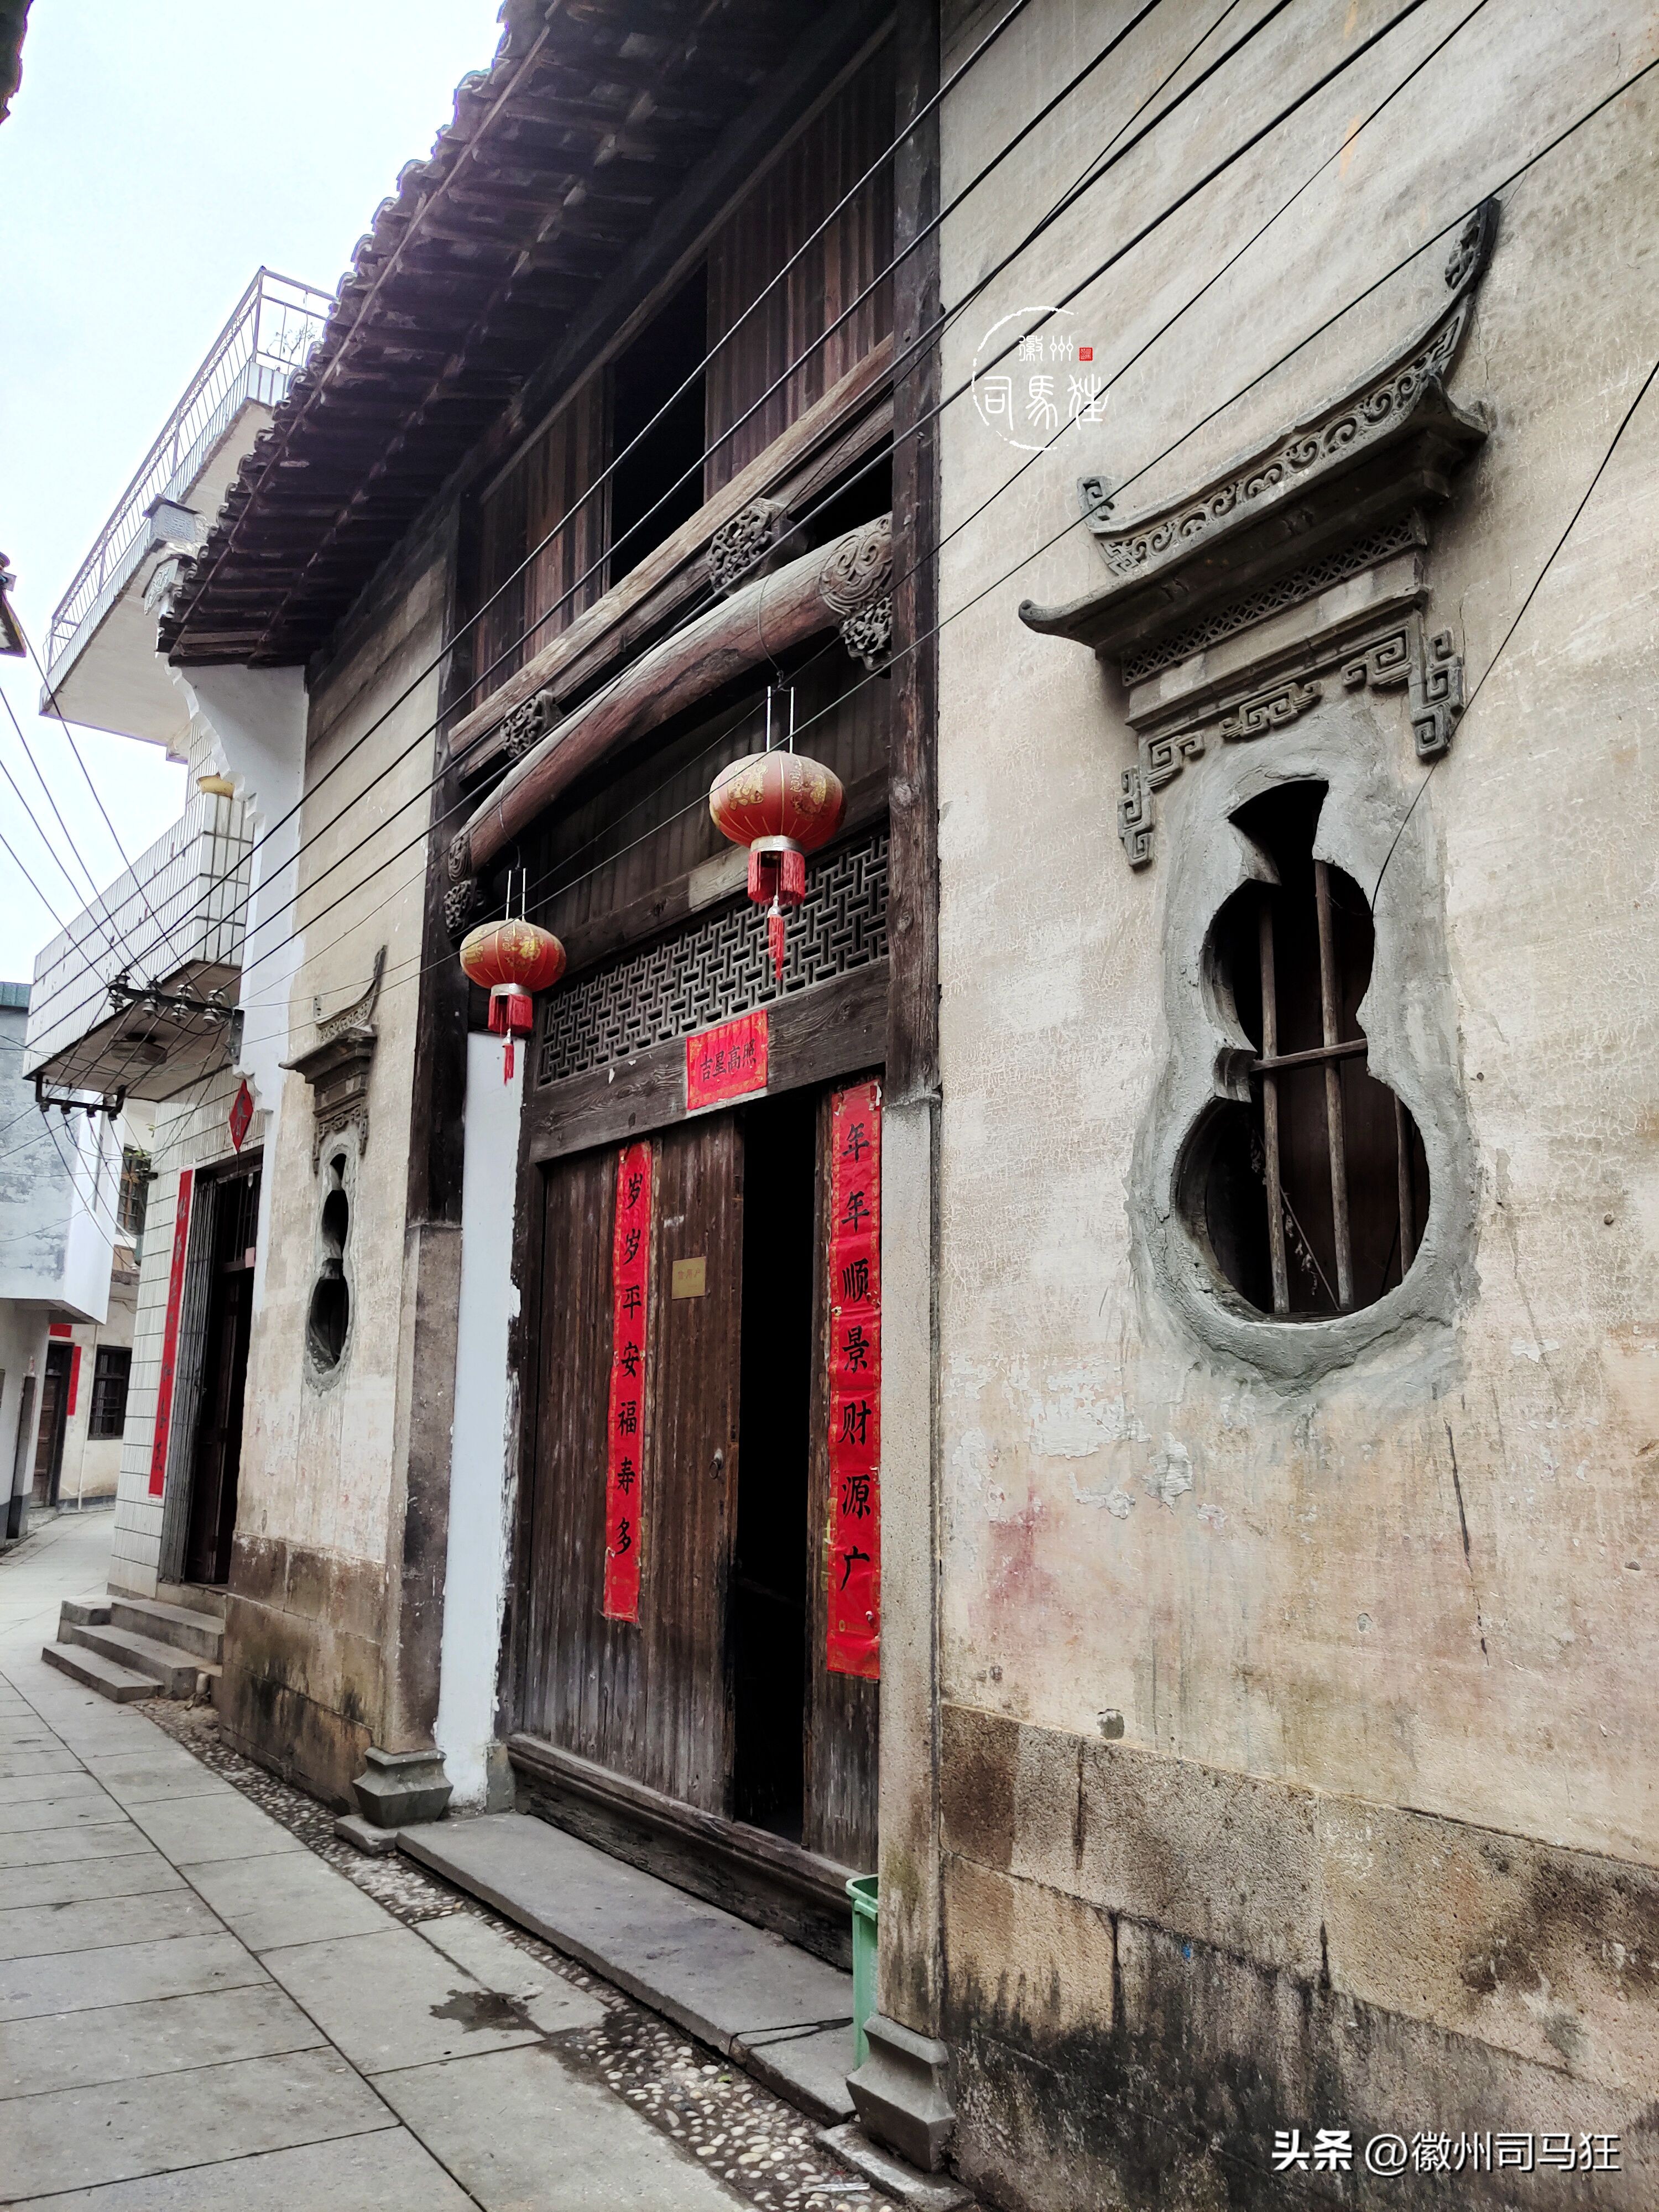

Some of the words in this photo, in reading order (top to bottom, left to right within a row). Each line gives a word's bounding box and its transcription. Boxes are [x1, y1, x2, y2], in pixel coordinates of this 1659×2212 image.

[700, 1038, 757, 1082] 吉星高照
[615, 1172, 644, 1556] 岁岁平安福寿多
[837, 1122, 873, 1592] 年年顺景财源广
